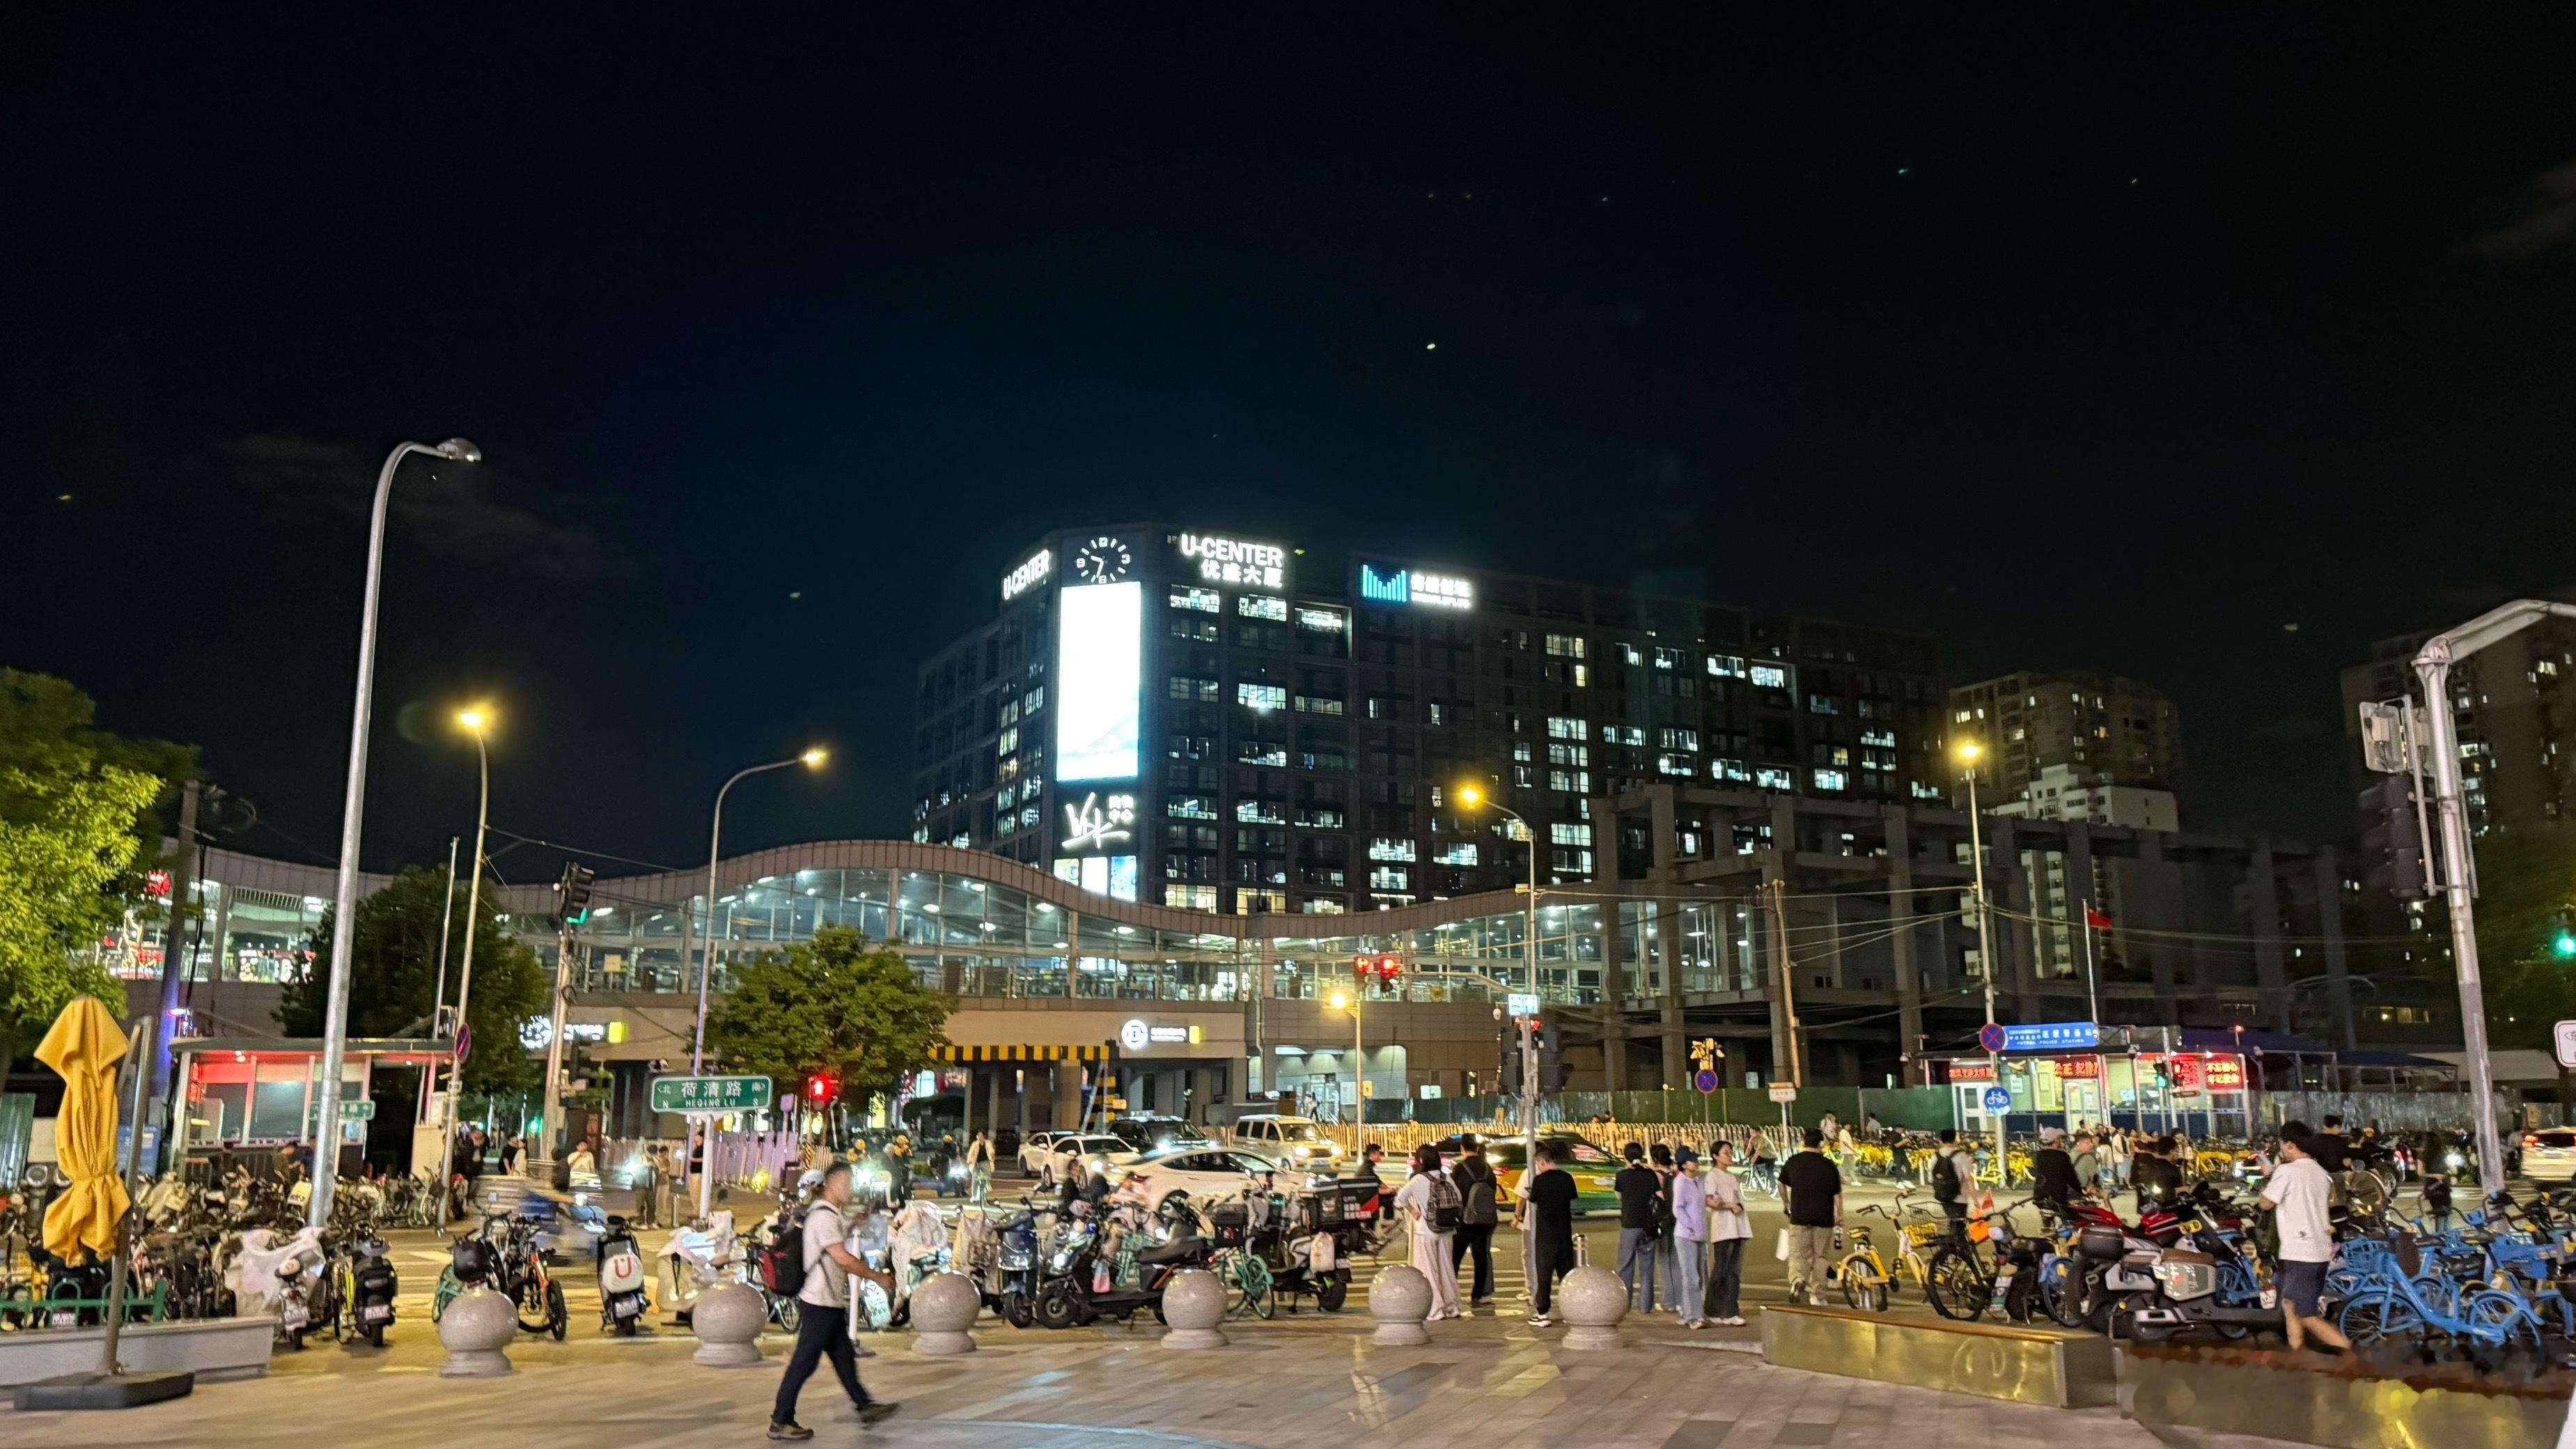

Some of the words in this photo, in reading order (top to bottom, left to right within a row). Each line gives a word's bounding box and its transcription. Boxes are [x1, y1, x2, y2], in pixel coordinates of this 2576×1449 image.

[1180, 534, 1283, 568] U-CENTER
[1003, 548, 1050, 600] U-CENTER
[681, 1080, 742, 1098] 荷清路
[662, 1099, 669, 1109] N
[685, 1099, 720, 1108] HEQING
[724, 1098, 736, 1107] LU
[753, 1098, 759, 1107] S
